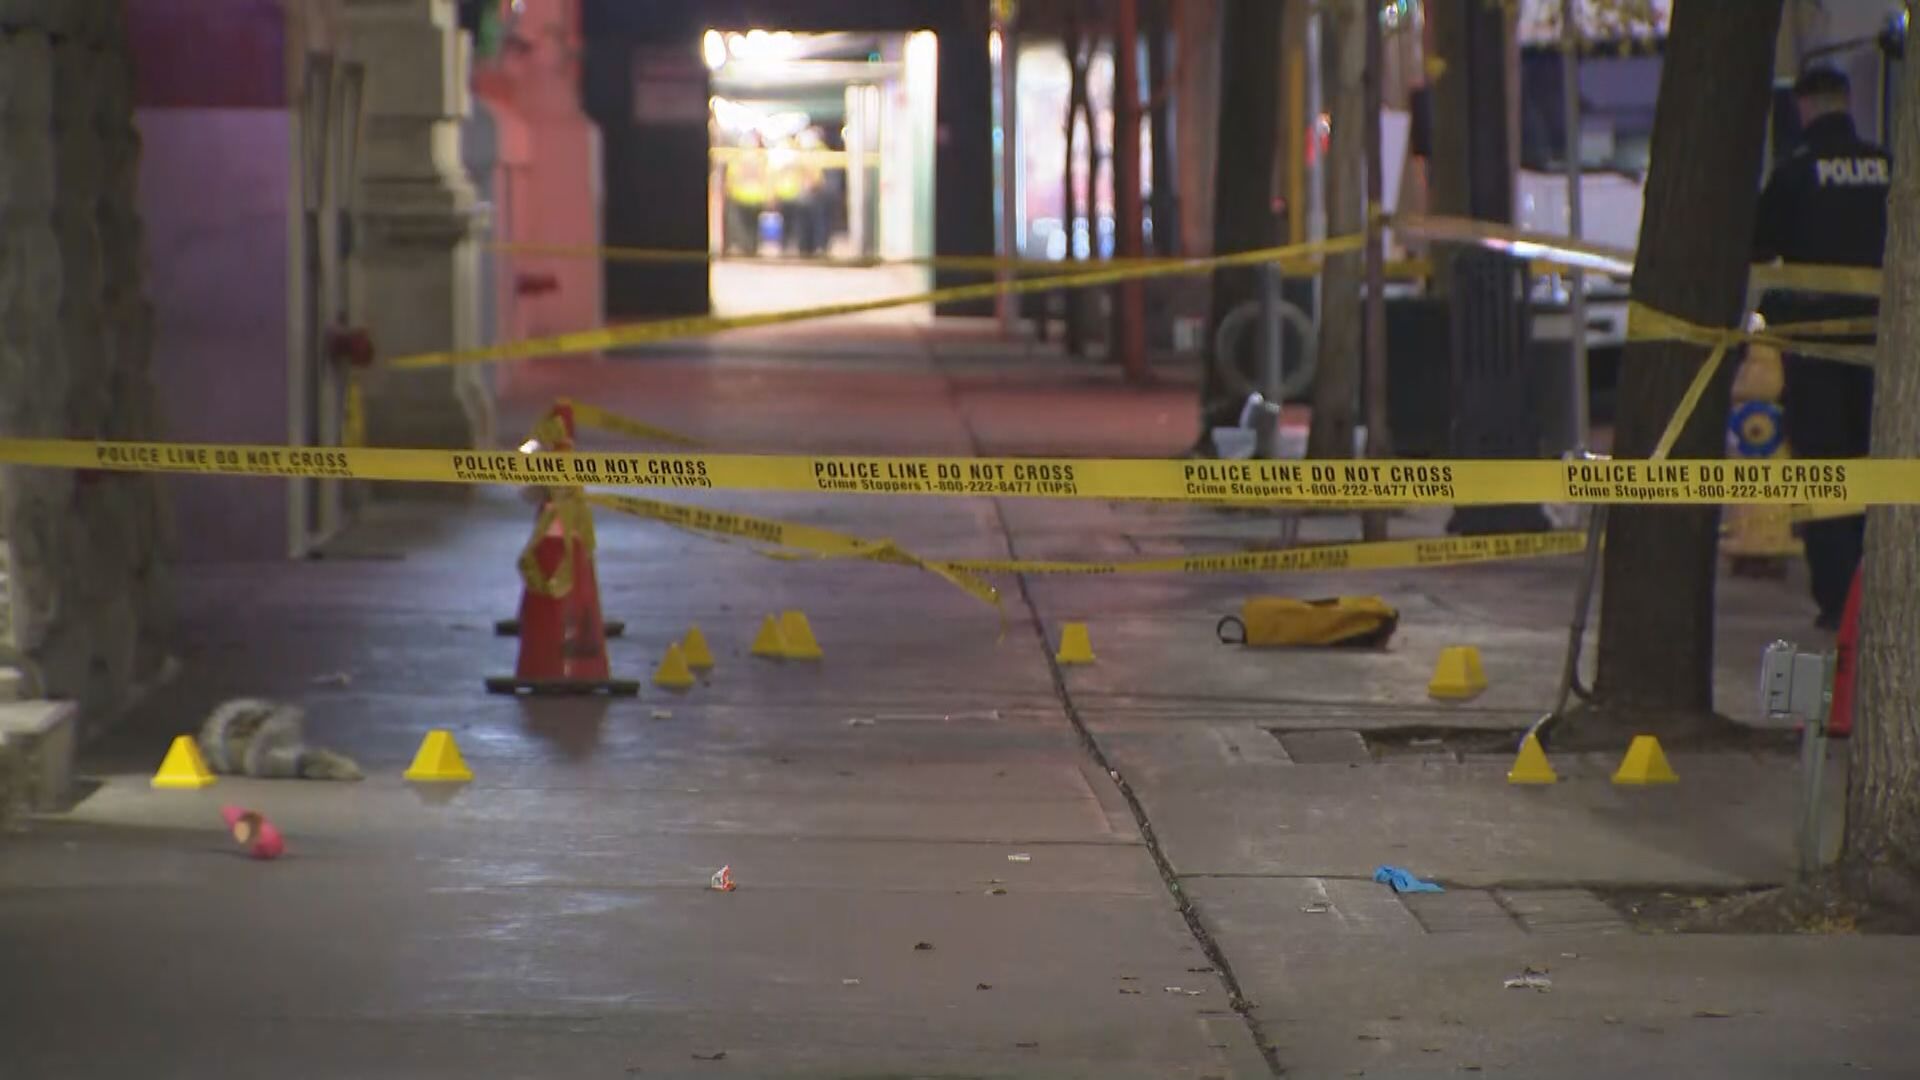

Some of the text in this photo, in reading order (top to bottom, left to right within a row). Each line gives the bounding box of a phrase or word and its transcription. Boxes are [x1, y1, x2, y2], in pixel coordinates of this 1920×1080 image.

[97, 447, 159, 463] POLICE
[168, 448, 207, 464] LINE
[216, 450, 239, 465] DO
[248, 451, 281, 466] NOT
[289, 452, 348, 468] CROSS
[454, 455, 707, 476] POLICE LINE DO NOT CROSS
[815, 462, 1074, 480] POLICE LINE DO NOT CROSS
[1184, 465, 1452, 482] POLICE LINE DO NOT CROSS
[1567, 465, 1846, 482] POLICE LINE DO NOT CROSS
[818, 478, 1077, 495] Crime Stoppers 1-800-222-8477 (TIPS)
[1187, 483, 1454, 498] Crime Stoppers 1-800-222-8477 (TIPS)
[1568, 485, 1847, 500] Crime Stoppers 1-800-222-8477 (TIPS)
